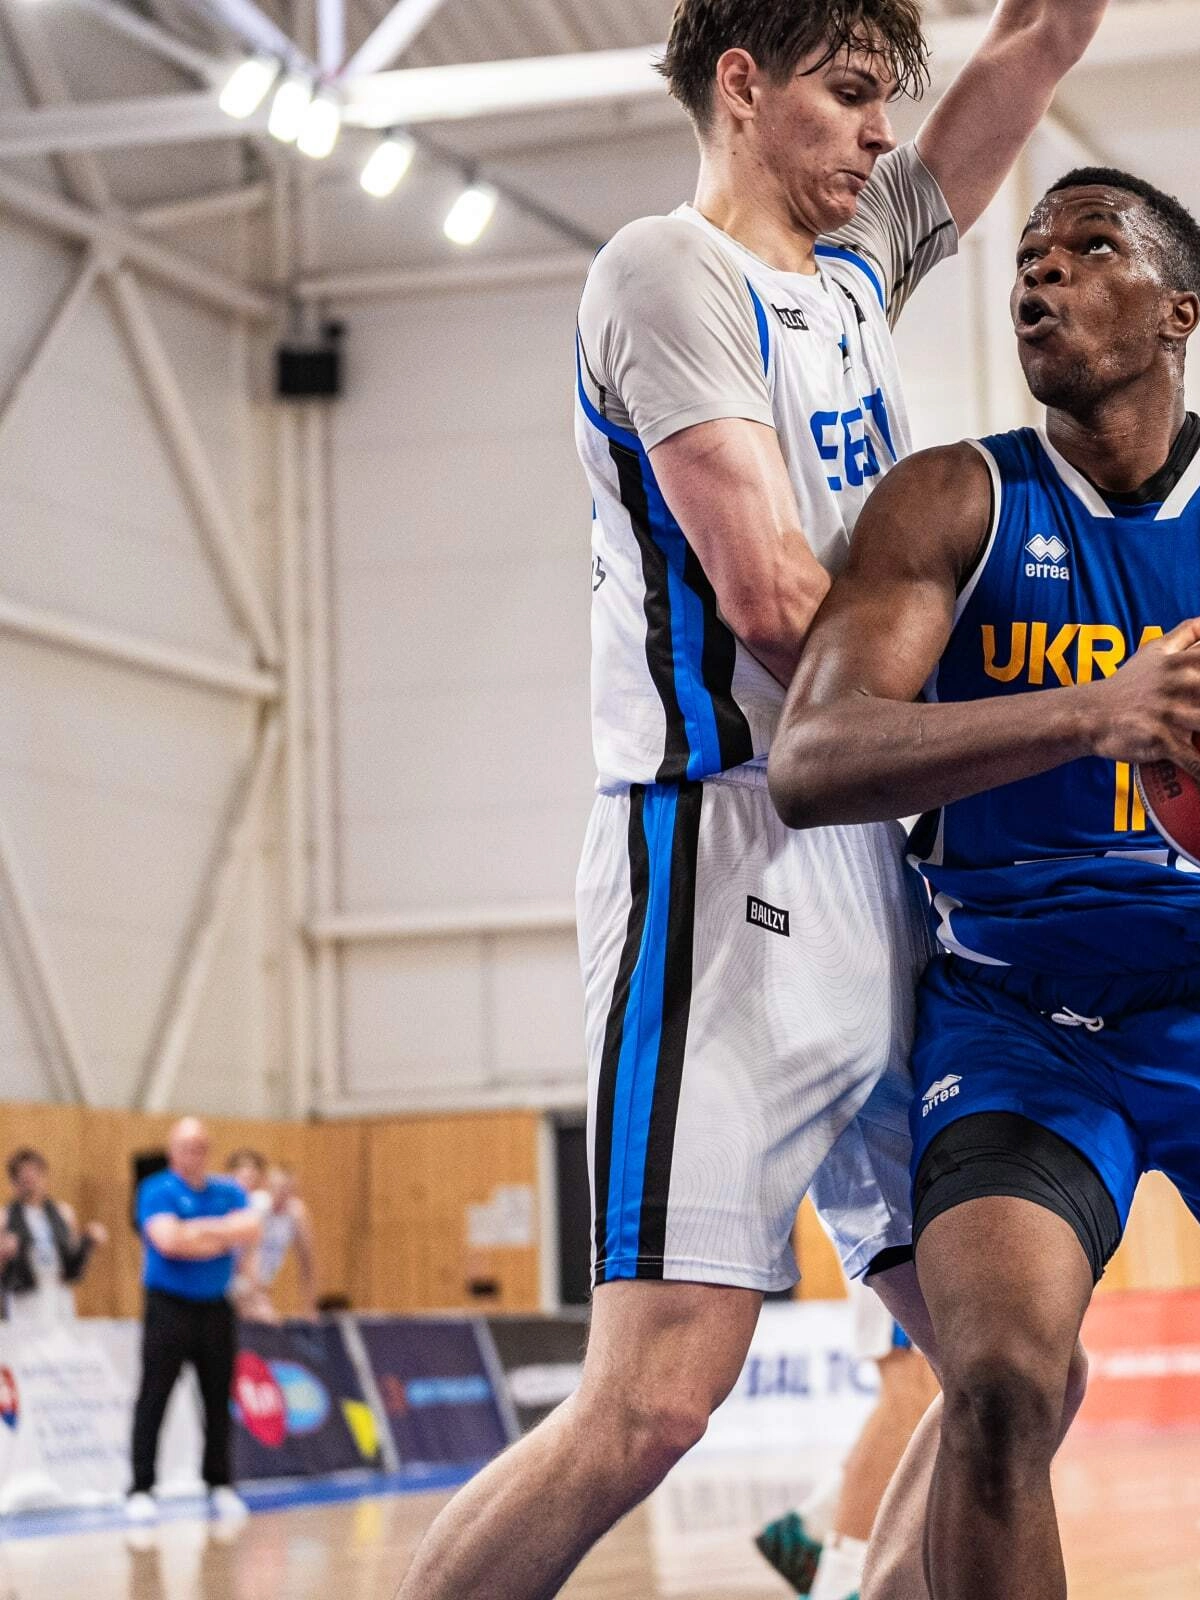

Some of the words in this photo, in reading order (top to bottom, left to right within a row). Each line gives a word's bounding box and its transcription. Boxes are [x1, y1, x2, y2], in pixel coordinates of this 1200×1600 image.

[1025, 563, 1070, 580] errea
[751, 901, 785, 931] BALLZY
[922, 1084, 960, 1118] errea
